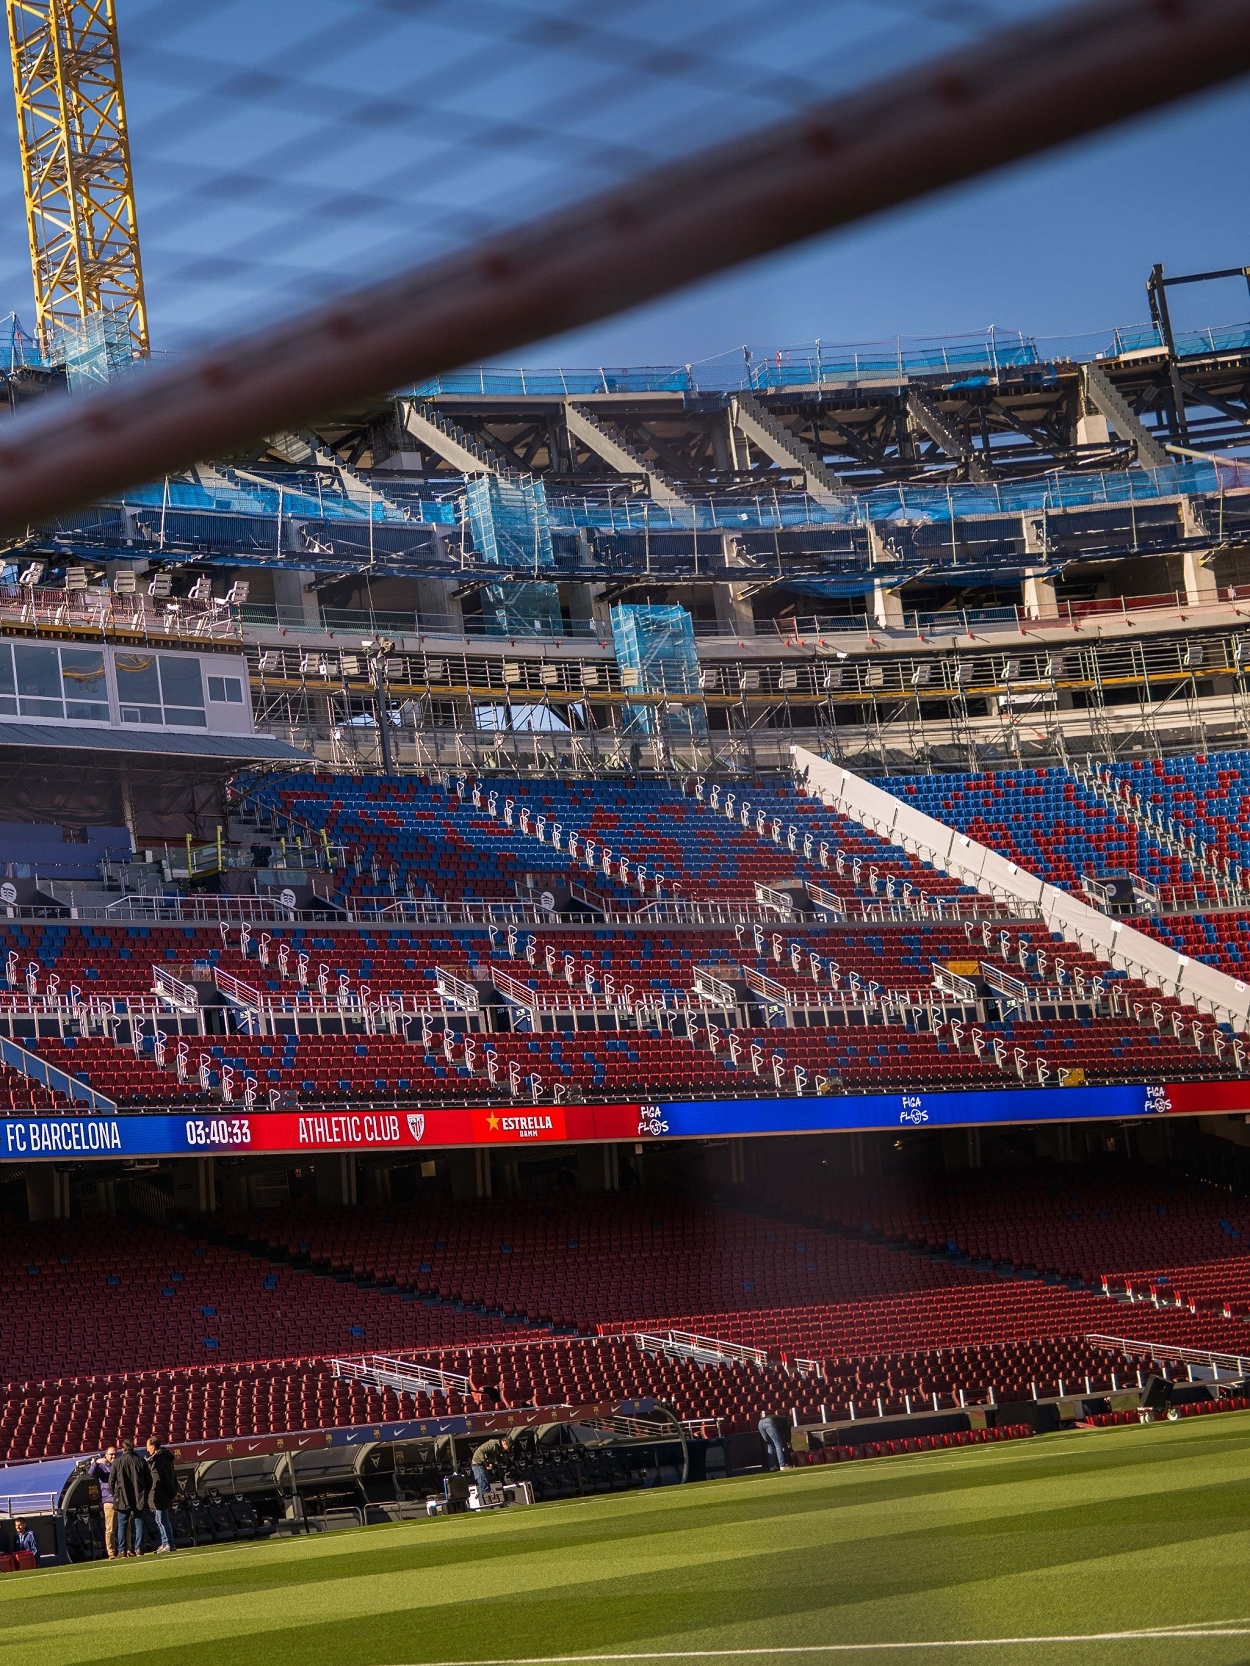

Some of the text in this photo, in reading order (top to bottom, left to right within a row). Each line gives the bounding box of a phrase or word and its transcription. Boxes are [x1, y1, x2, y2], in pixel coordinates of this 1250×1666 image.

[6, 1121, 121, 1151] FC BARCELONA
[186, 1119, 251, 1145] 03:40:33
[299, 1115, 400, 1143] ATHLETIC CLUB
[502, 1116, 553, 1131] ESTRELLA
[519, 1130, 538, 1138] DAMM
